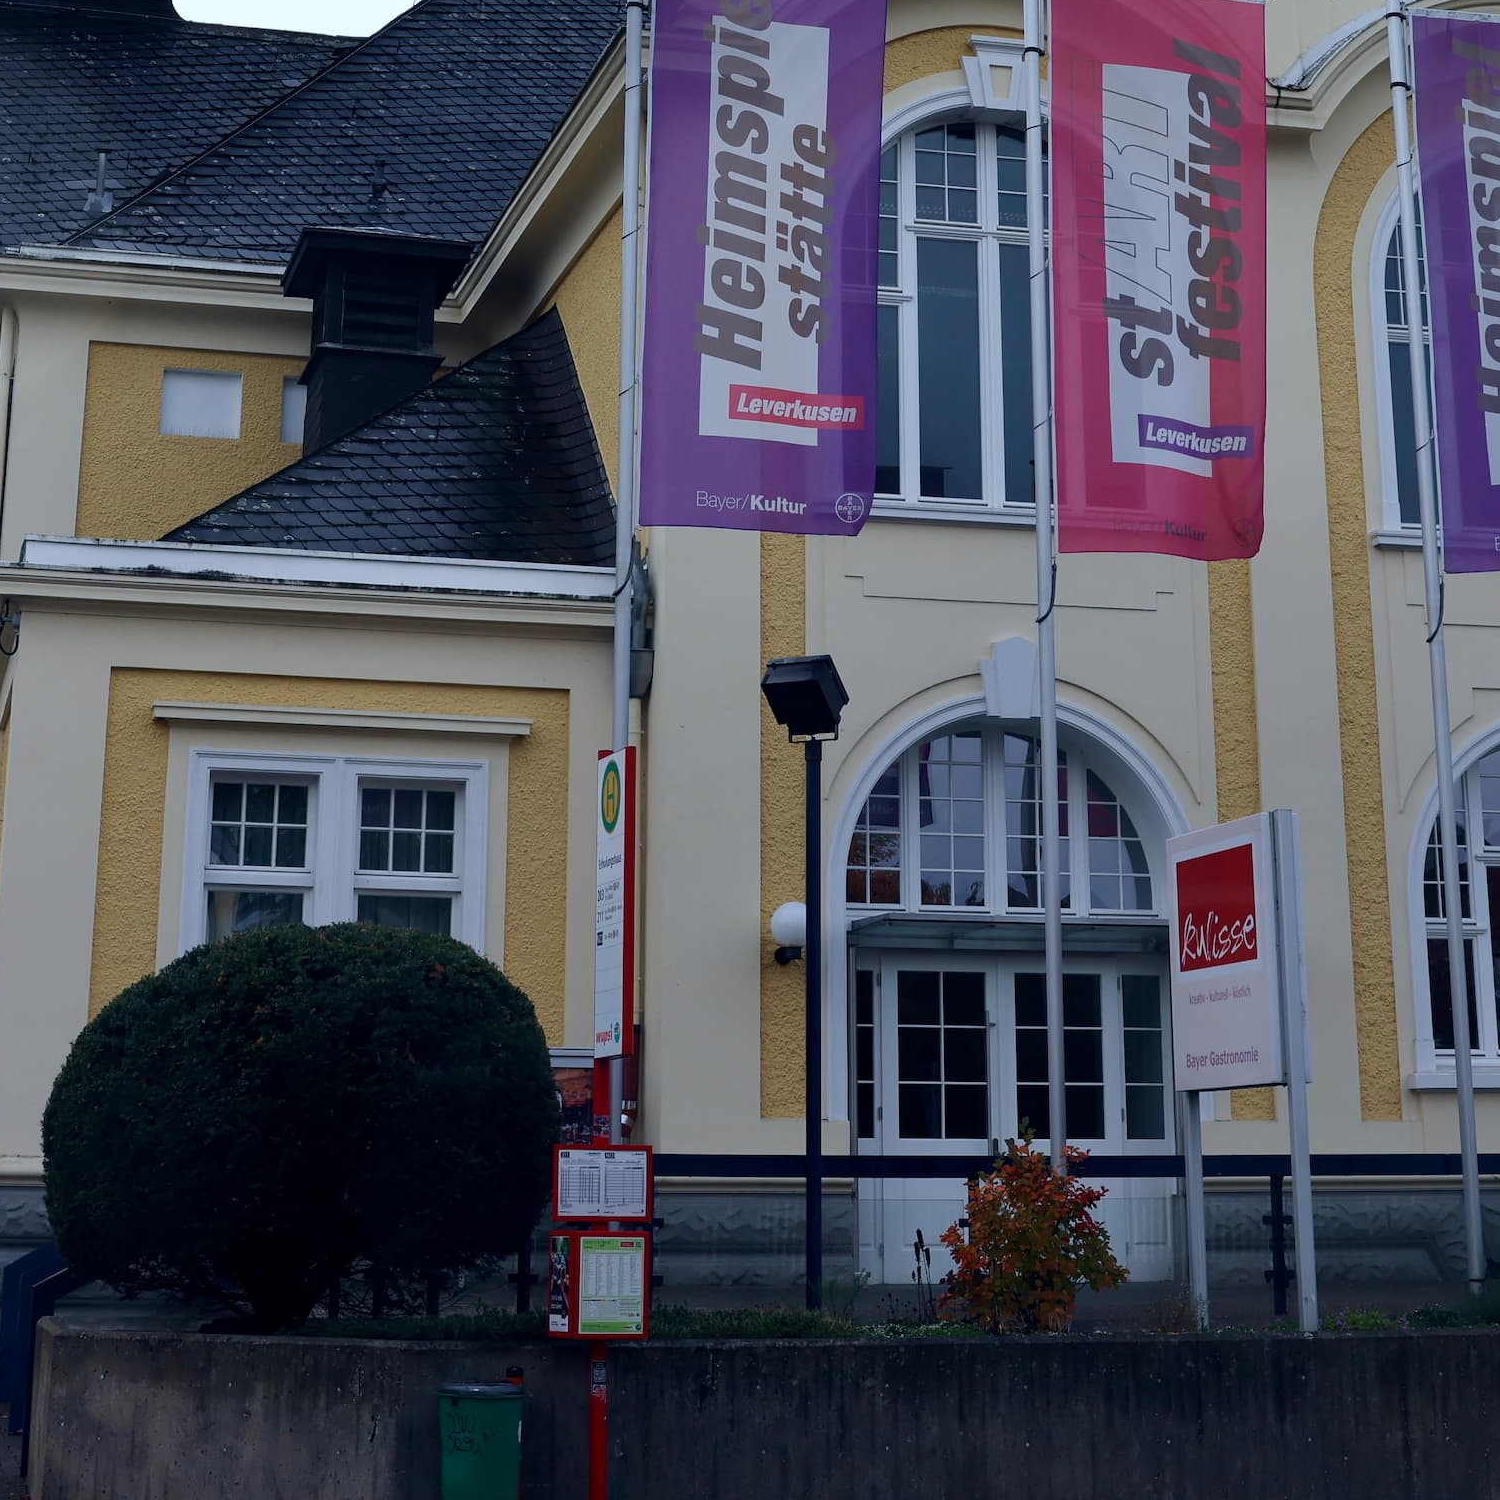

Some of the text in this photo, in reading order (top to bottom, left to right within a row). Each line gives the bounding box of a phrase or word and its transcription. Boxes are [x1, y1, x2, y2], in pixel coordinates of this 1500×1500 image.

[1173, 37, 1244, 362] festival
[776, 122, 838, 345] stätte
[1071, 55, 1176, 387] stART
[736, 390, 858, 425] Leverkusen
[1145, 421, 1248, 455] Leverkusen
[695, 489, 808, 515] Bayer/Kultur
[596, 1023, 613, 1046] wupsi
[1186, 1046, 1259, 1071] Bayer Gastronomie
